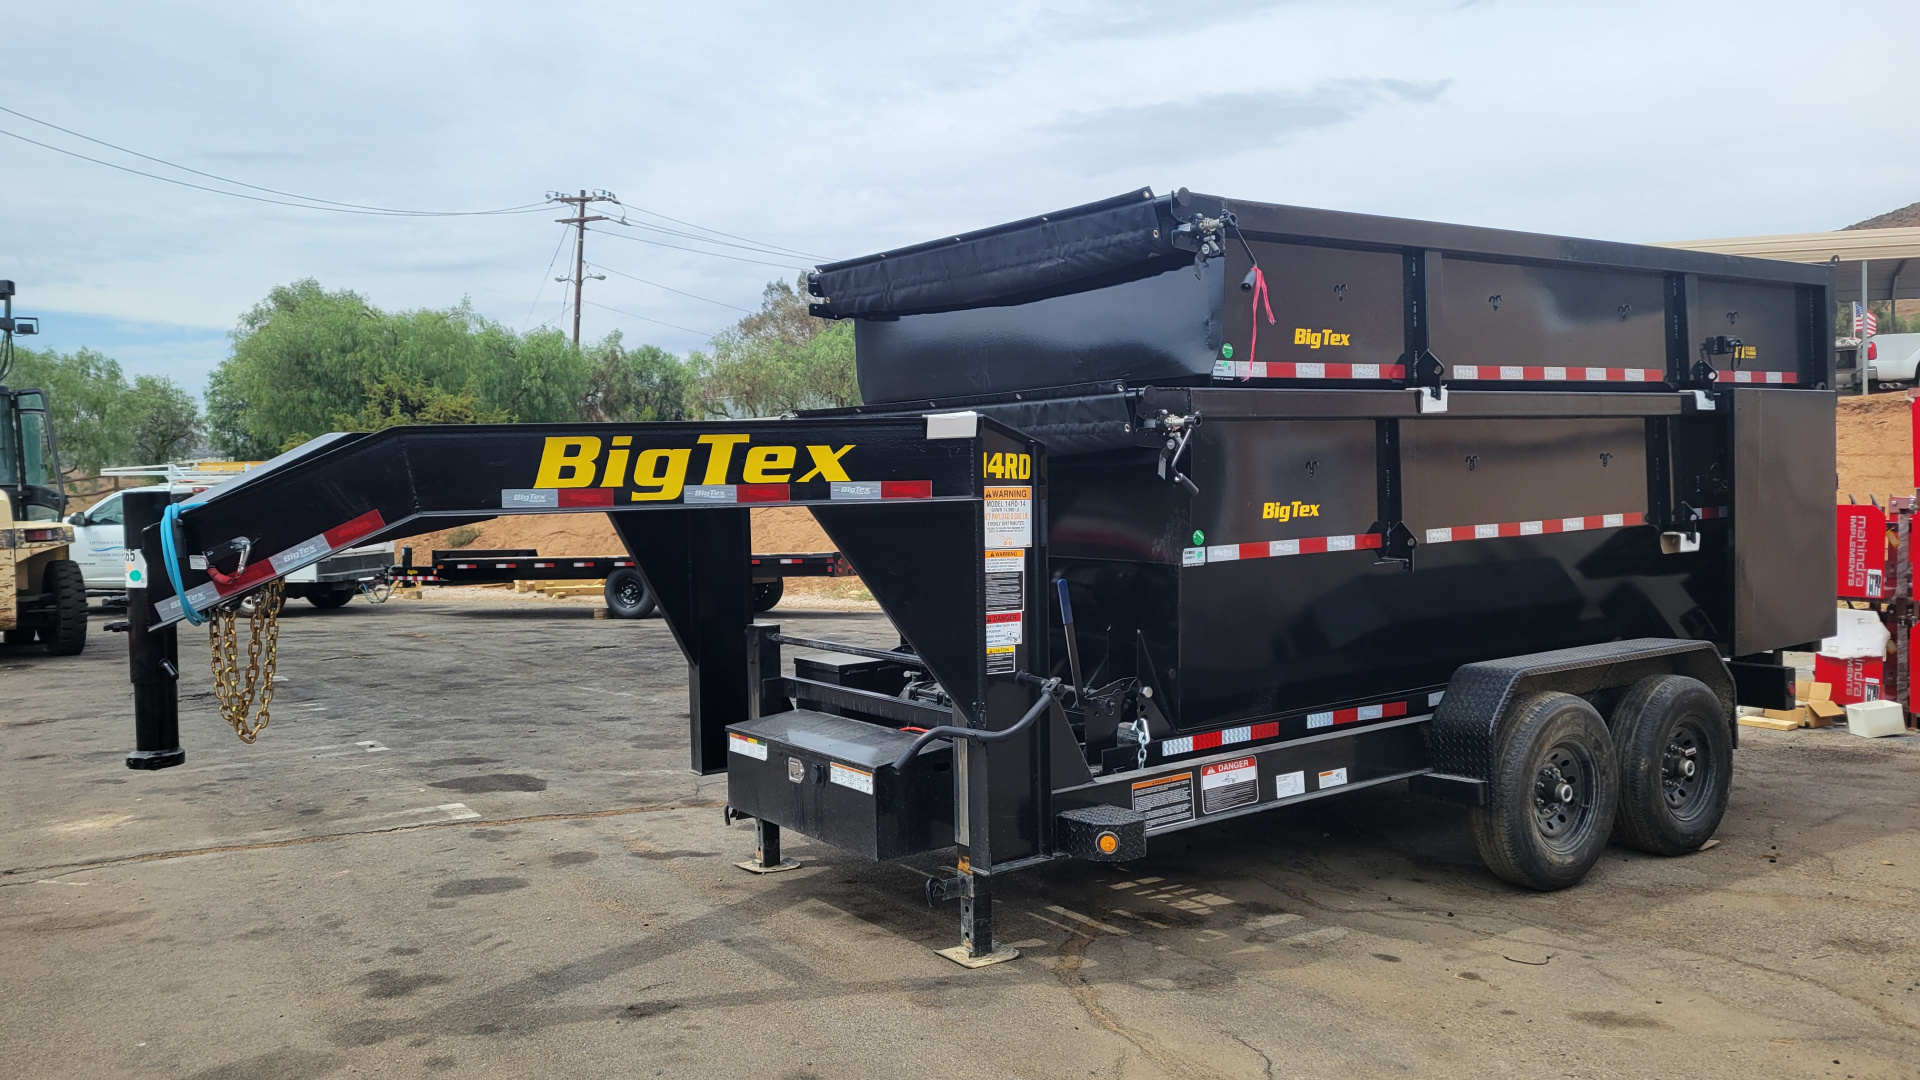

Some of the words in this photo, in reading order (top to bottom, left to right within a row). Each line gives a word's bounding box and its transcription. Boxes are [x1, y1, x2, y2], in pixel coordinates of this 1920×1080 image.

[533, 434, 857, 501] BigTex
[991, 490, 1027, 498] WARNING
[986, 500, 1004, 508] MODEL
[1848, 515, 1857, 587] IMPLEMENTS
[1856, 515, 1867, 588] mahindra
[993, 614, 1017, 622] DANGER
[1218, 759, 1249, 772] DANGER
